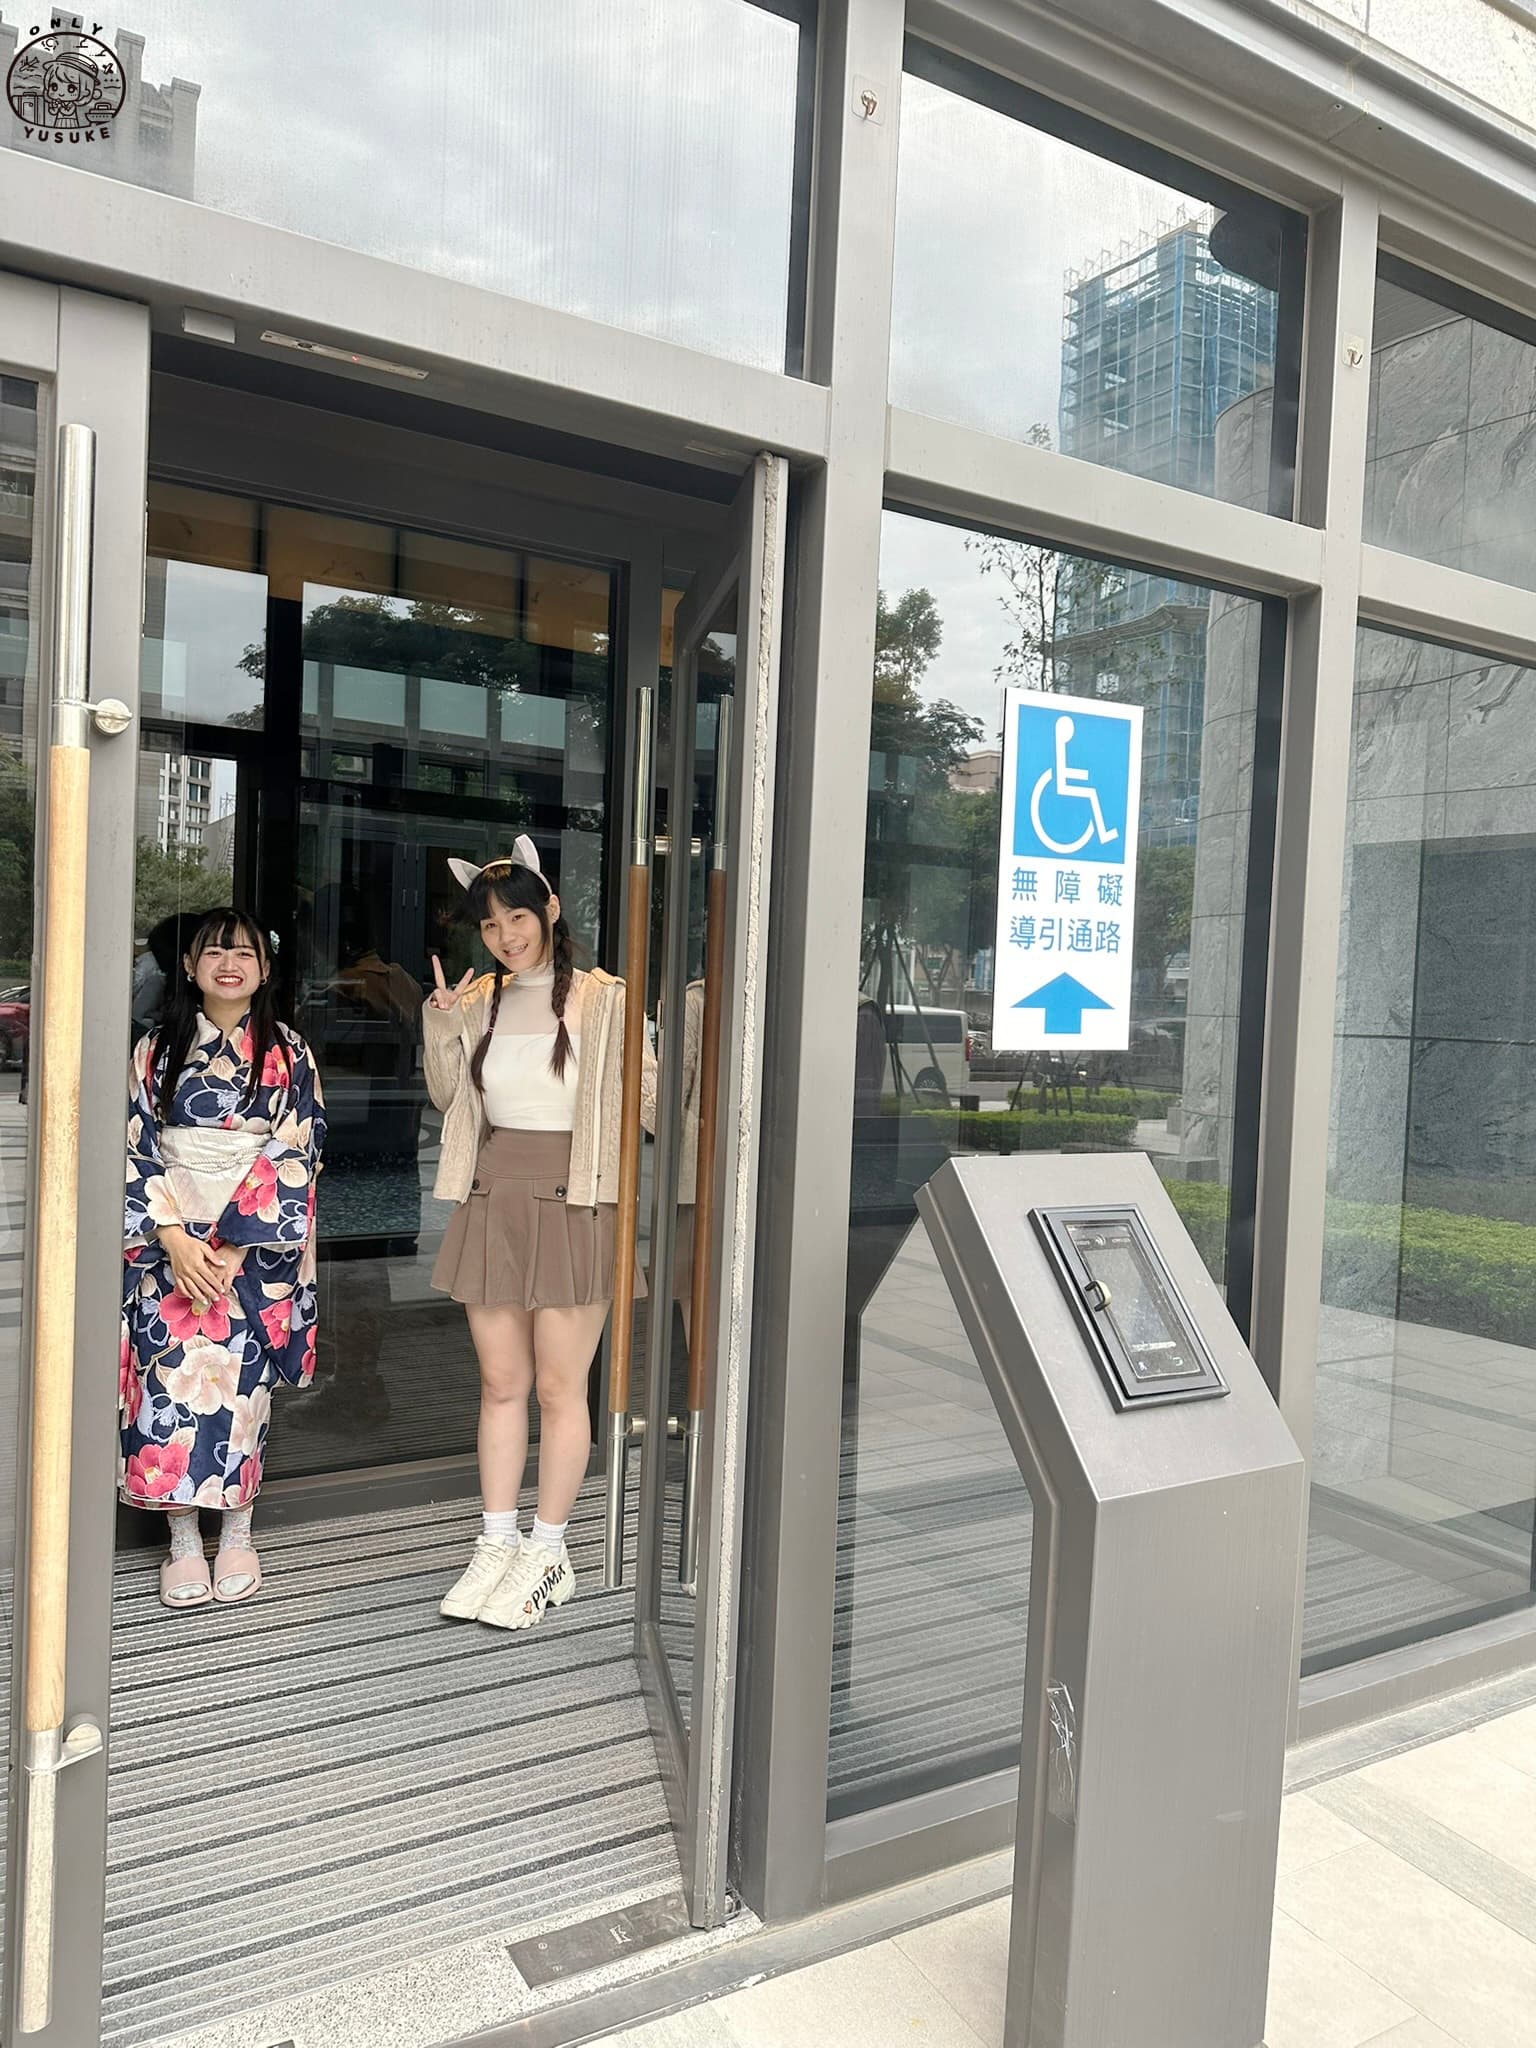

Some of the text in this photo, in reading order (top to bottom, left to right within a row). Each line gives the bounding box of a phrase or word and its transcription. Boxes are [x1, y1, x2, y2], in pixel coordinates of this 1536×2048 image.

[1011, 866, 1123, 907] 無障礙
[1009, 915, 1121, 954] 導引通路
[532, 1563, 566, 1610] PUMA
